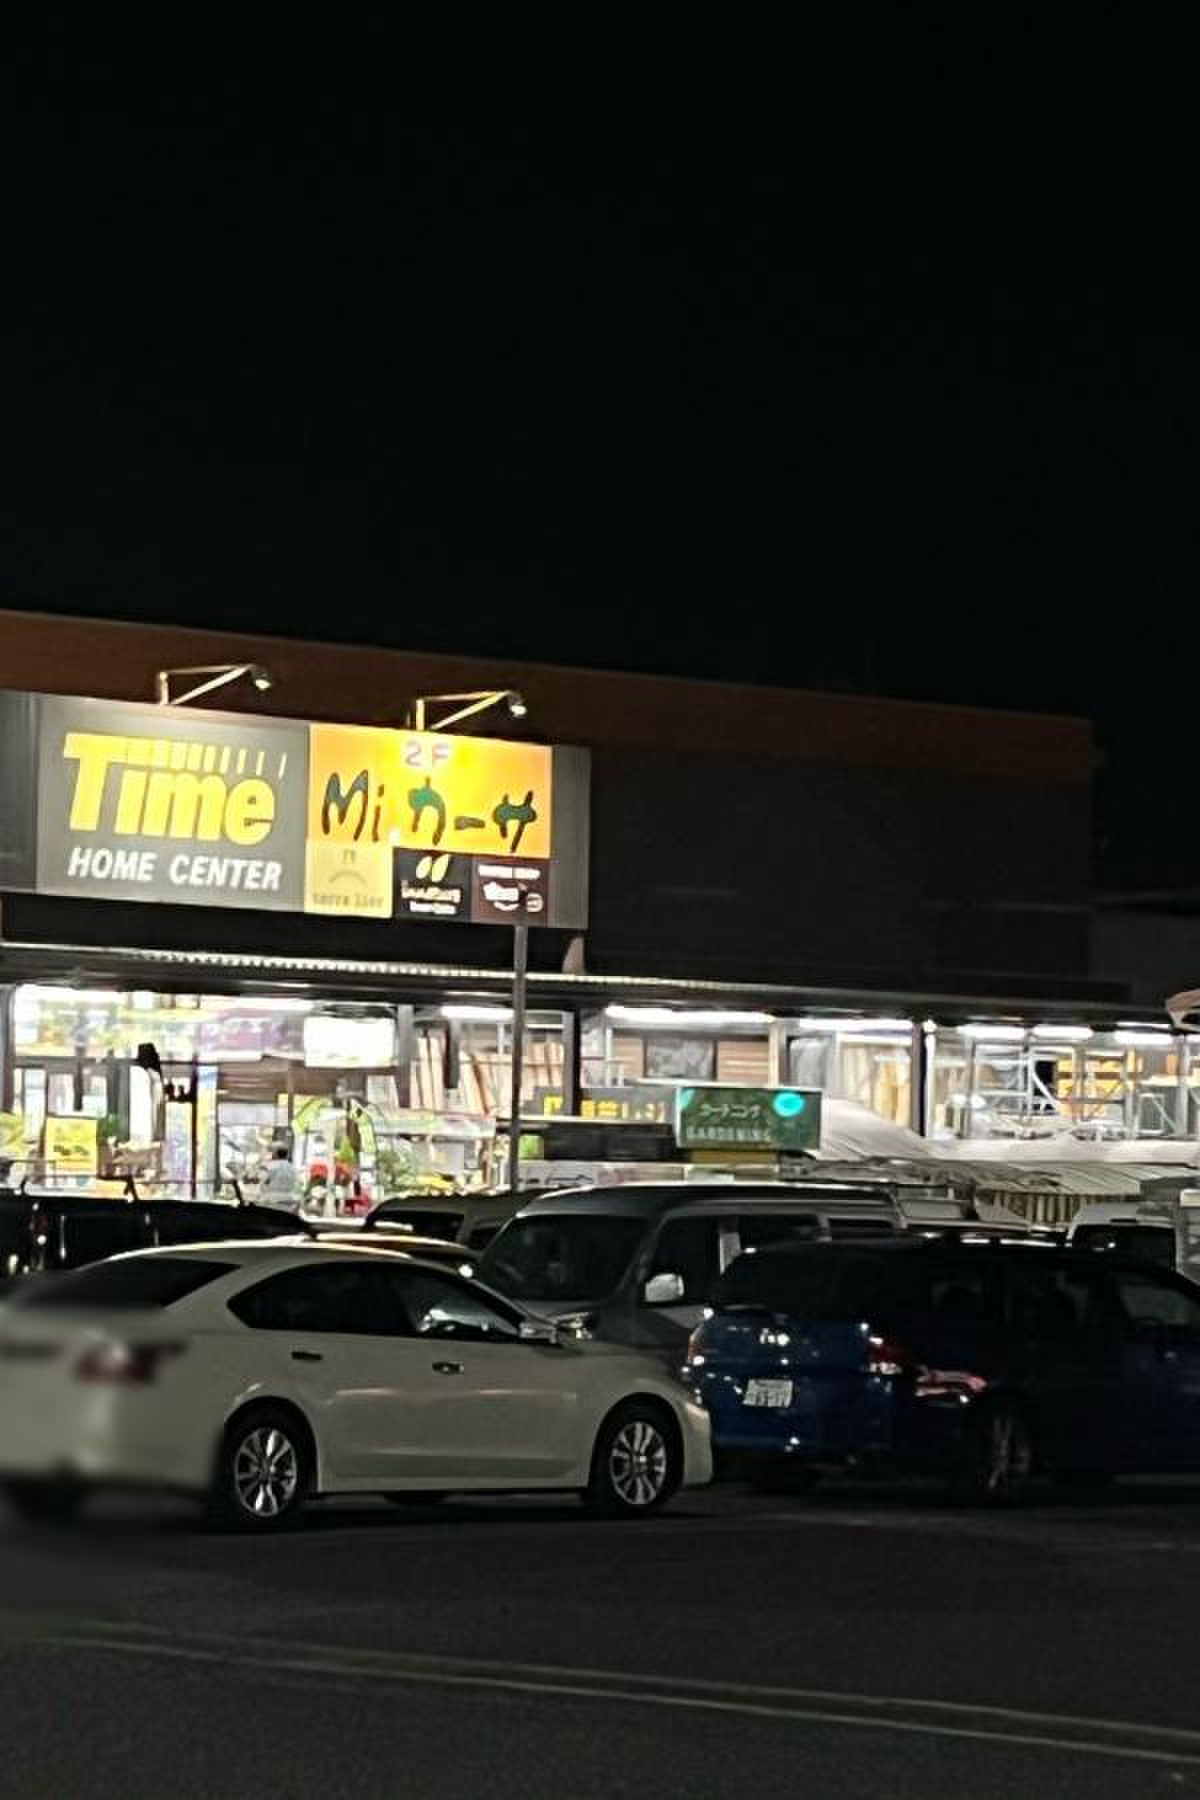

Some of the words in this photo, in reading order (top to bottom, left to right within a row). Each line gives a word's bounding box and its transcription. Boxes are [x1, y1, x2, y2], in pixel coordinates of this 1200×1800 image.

[405, 740, 450, 768] 2F
[63, 732, 287, 846] Time
[67, 847, 158, 882] HOME
[169, 854, 282, 891] CENTER
